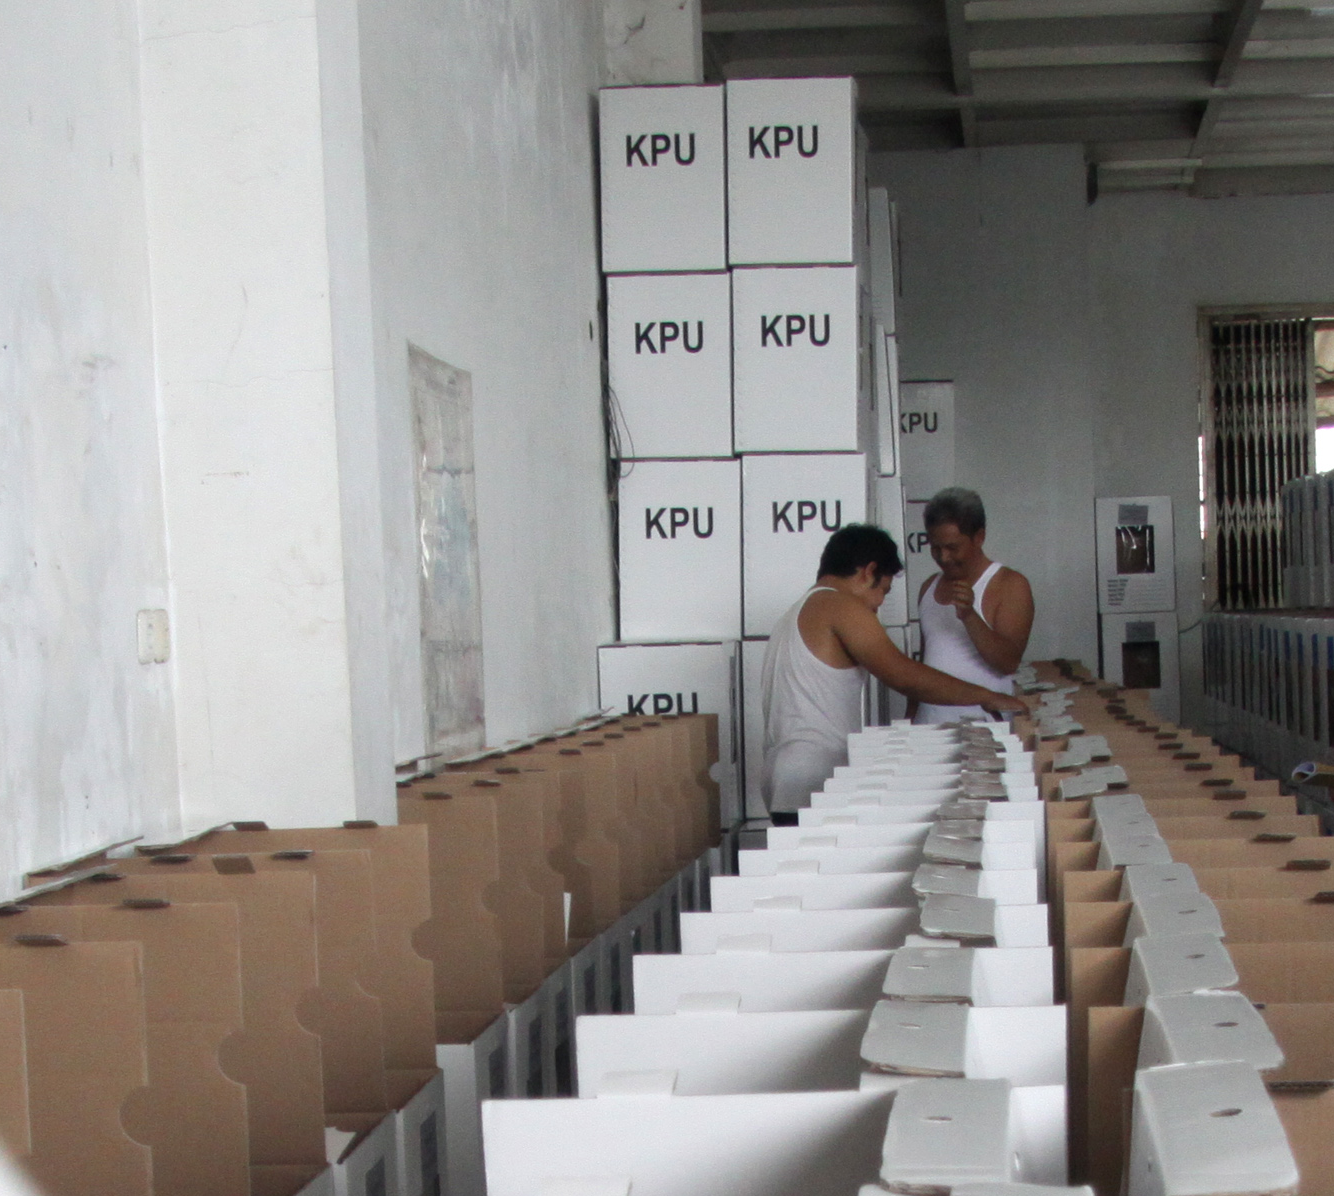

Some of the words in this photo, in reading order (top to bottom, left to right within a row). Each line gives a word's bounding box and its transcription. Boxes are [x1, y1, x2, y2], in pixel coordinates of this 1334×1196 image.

[626, 133, 696, 167] KPU
[749, 125, 818, 159] KPU
[635, 321, 704, 354] KPU
[761, 314, 830, 347] KPU
[645, 507, 714, 539] KPU
[772, 500, 842, 532] KPU
[907, 533, 929, 553] KP
[627, 692, 698, 716] KPU
